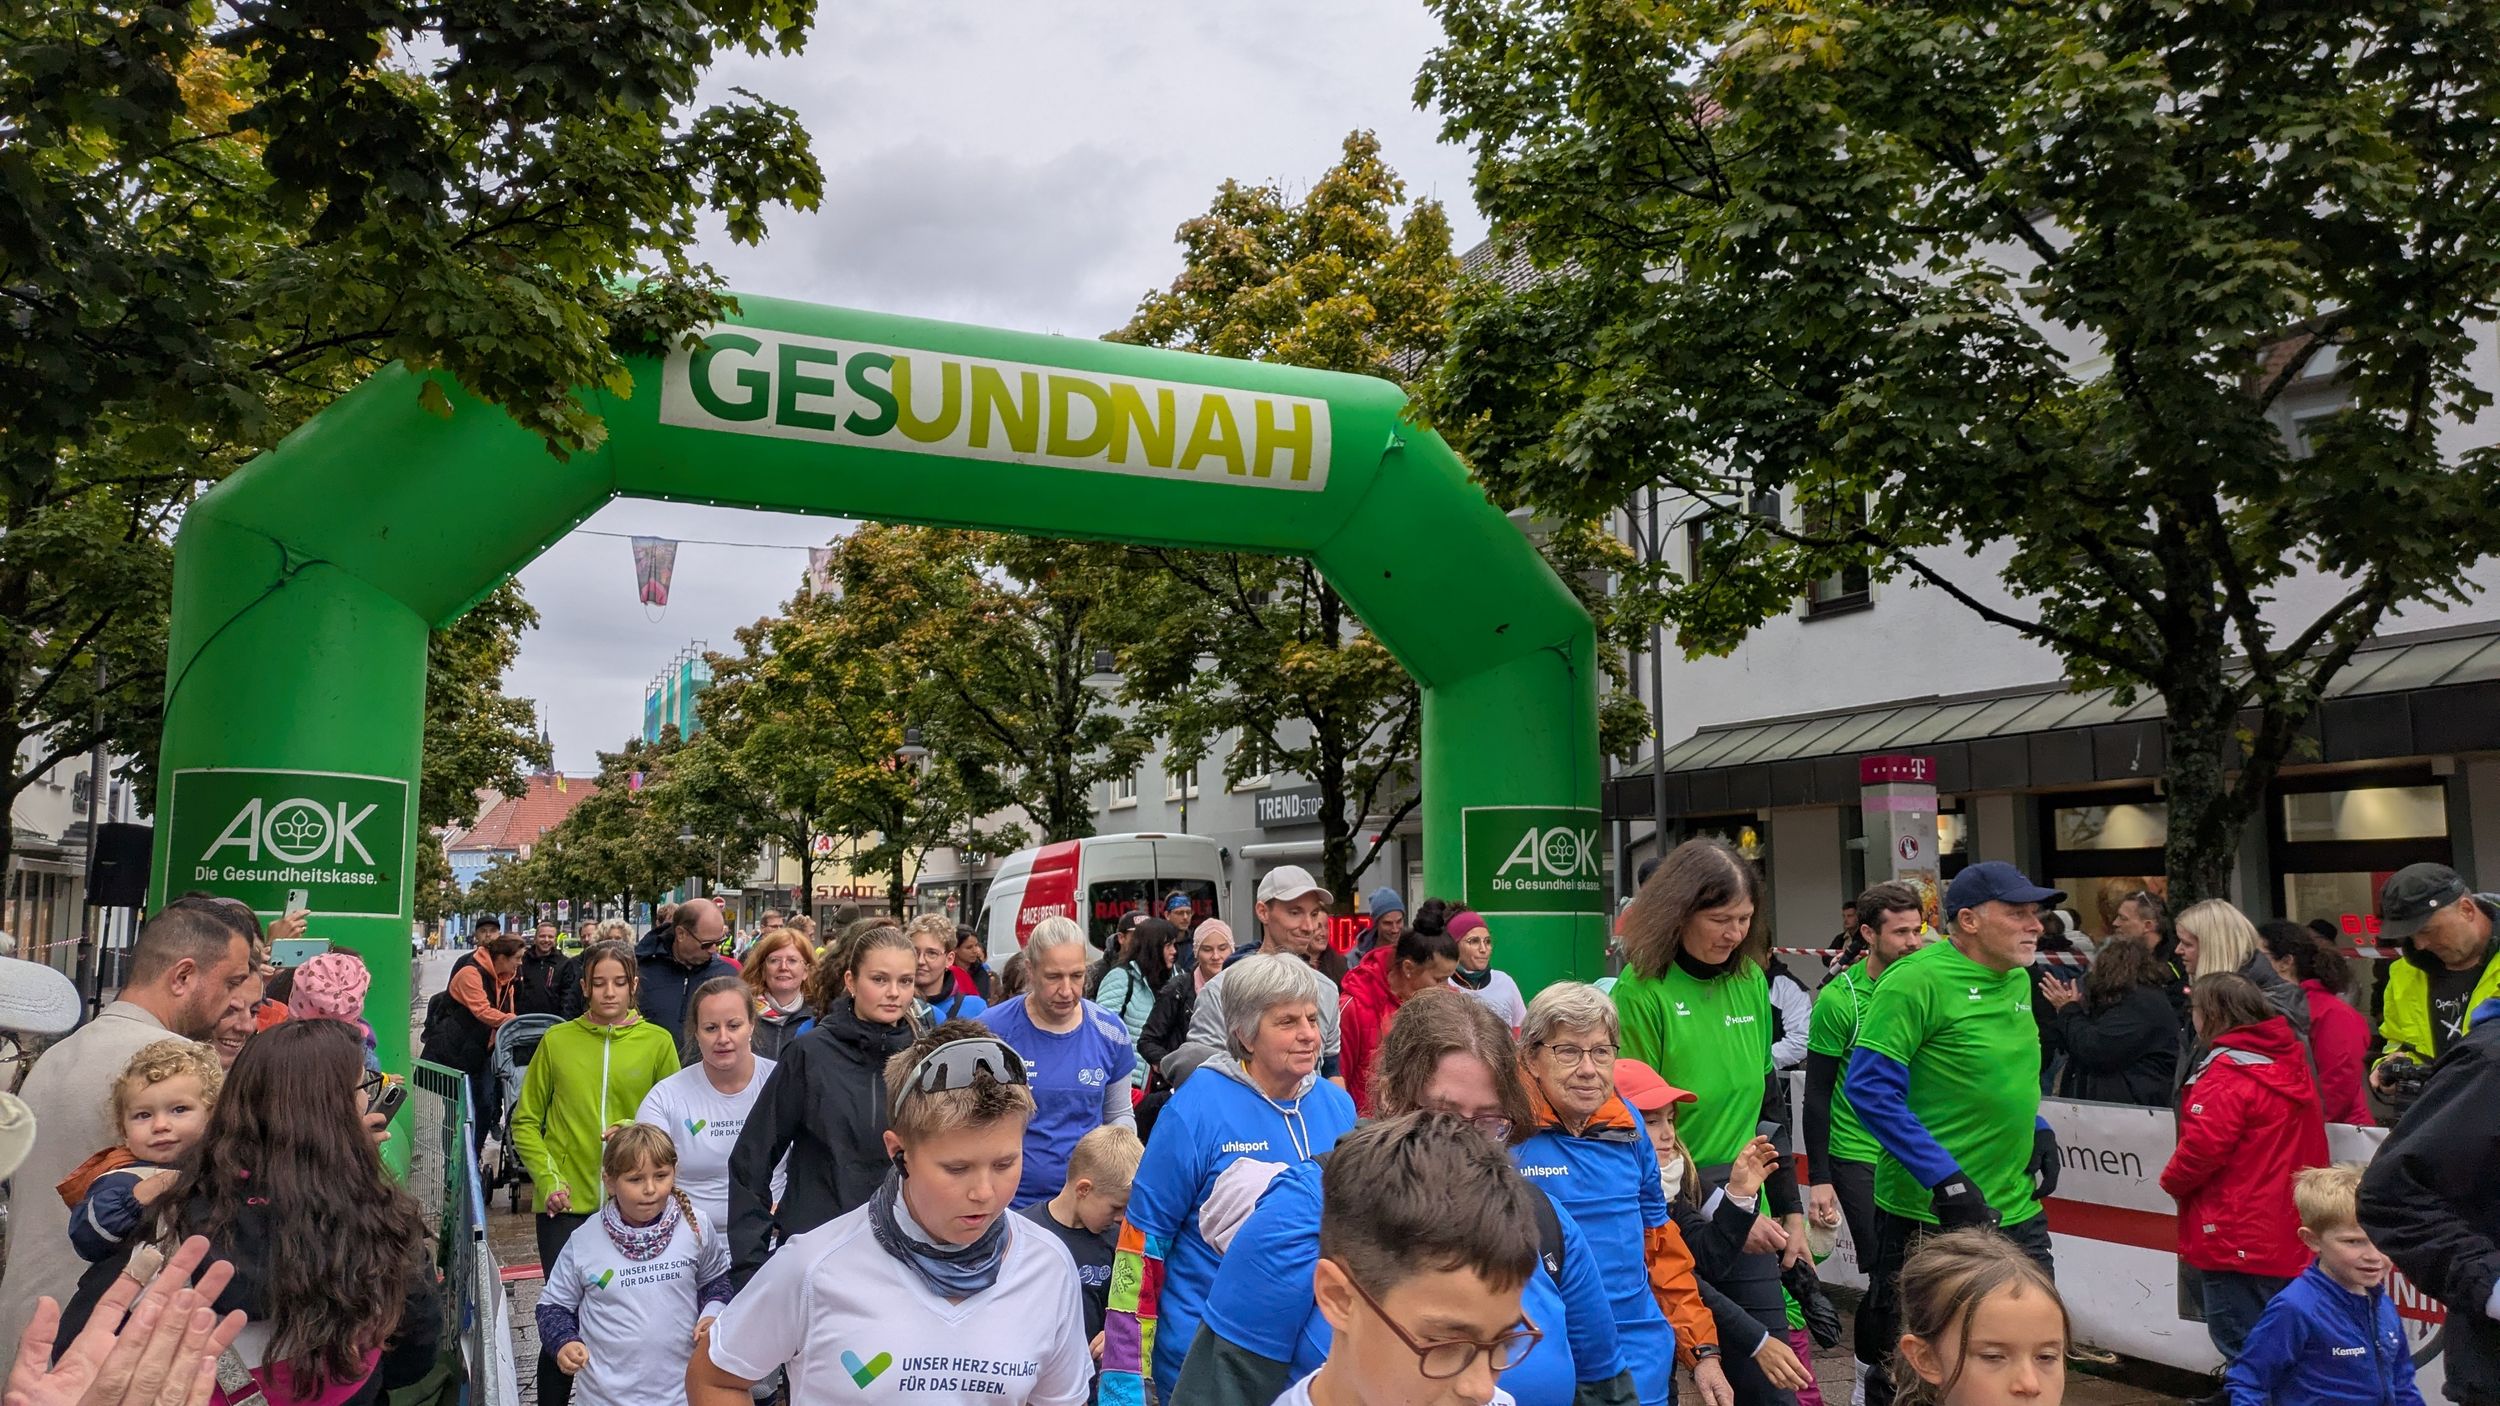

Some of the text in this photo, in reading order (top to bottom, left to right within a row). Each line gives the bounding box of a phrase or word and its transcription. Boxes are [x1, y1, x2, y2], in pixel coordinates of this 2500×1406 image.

[688, 333, 1311, 481] GESUNDNAH
[200, 798, 379, 865] AOK
[1496, 827, 1599, 876] AOK
[195, 866, 378, 884] Die Gesundheitskasse.
[1493, 878, 1512, 890] Die
[711, 1120, 734, 1128] UNSER
[711, 1129, 723, 1137] FÜR
[1222, 1141, 1269, 1153] uhlsport
[1520, 1165, 1569, 1178] uhlsport
[620, 1265, 647, 1276] UNSER
[649, 1262, 669, 1272] HERZ
[620, 1272, 682, 1288] FÜR DAS LEBEN.
[2332, 1347, 2366, 1356] Kempa
[902, 1357, 1038, 1377] UNSER HERZ SCHLÄGT
[899, 1376, 1006, 1395] FÜR DAS LEBEN.
